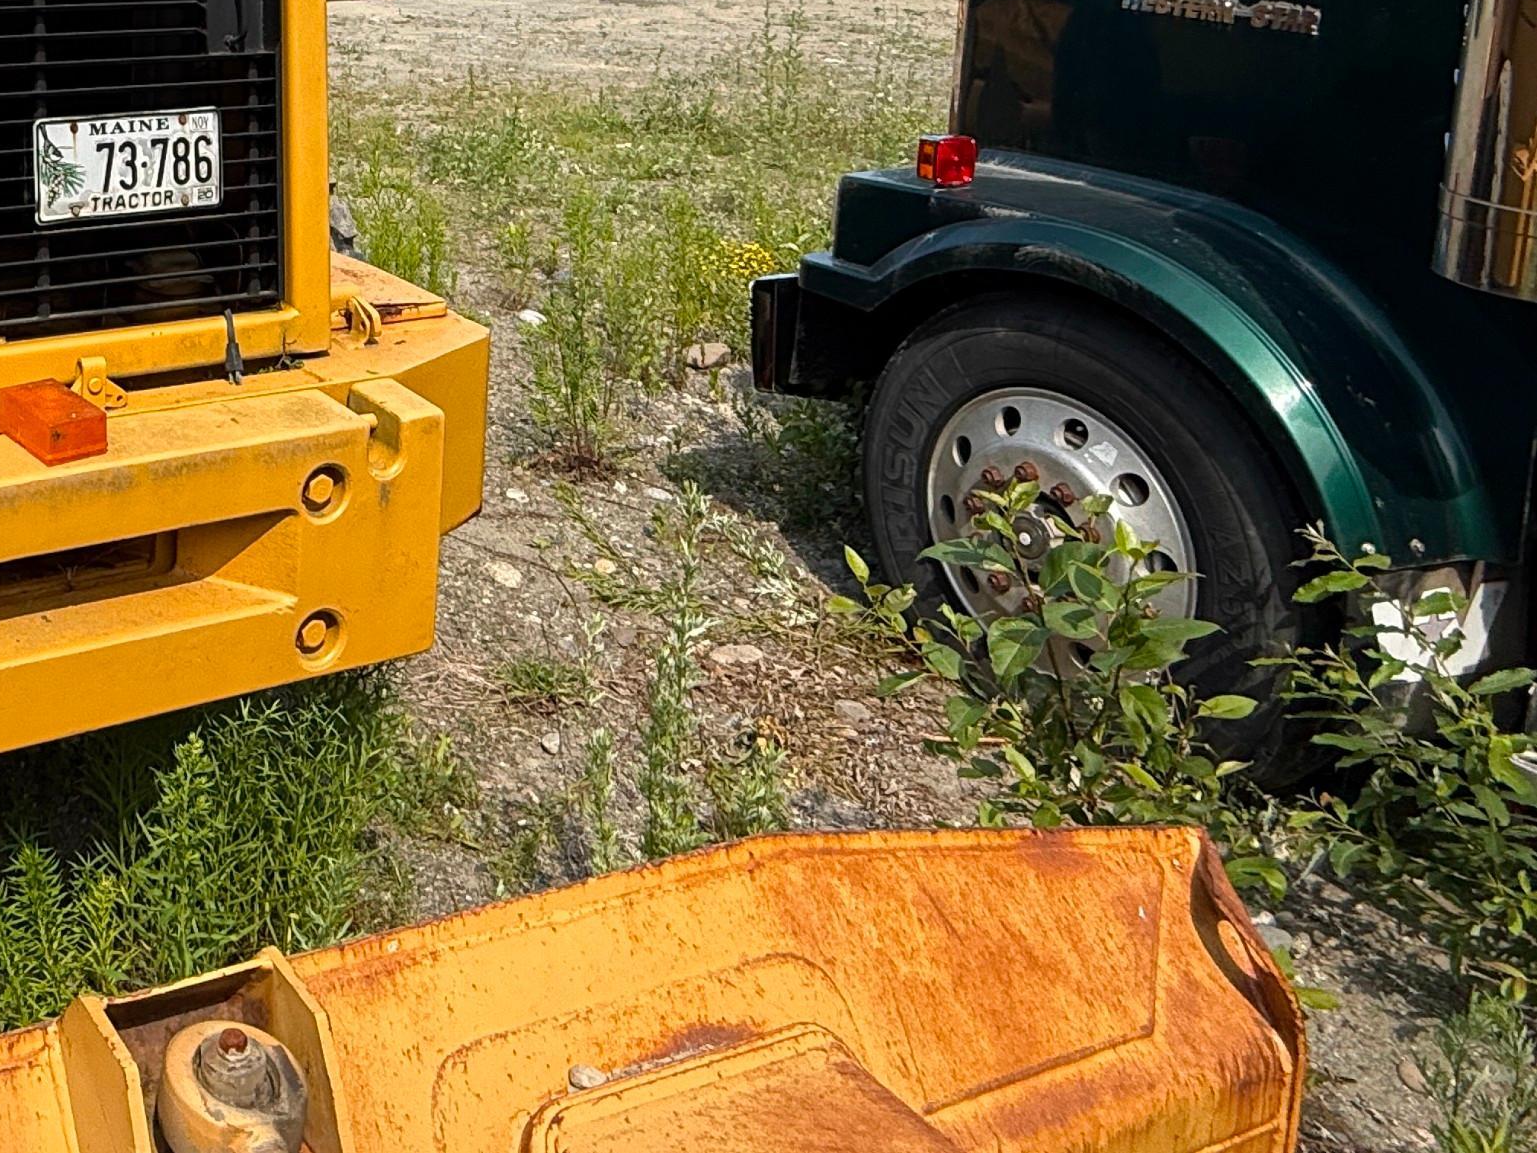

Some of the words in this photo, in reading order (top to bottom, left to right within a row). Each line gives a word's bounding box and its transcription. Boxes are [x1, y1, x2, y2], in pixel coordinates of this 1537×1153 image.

[1250, 0, 1322, 36] STAR
[89, 117, 170, 136] MAINE
[191, 115, 209, 130] NOV
[91, 190, 174, 210] TRACTOR
